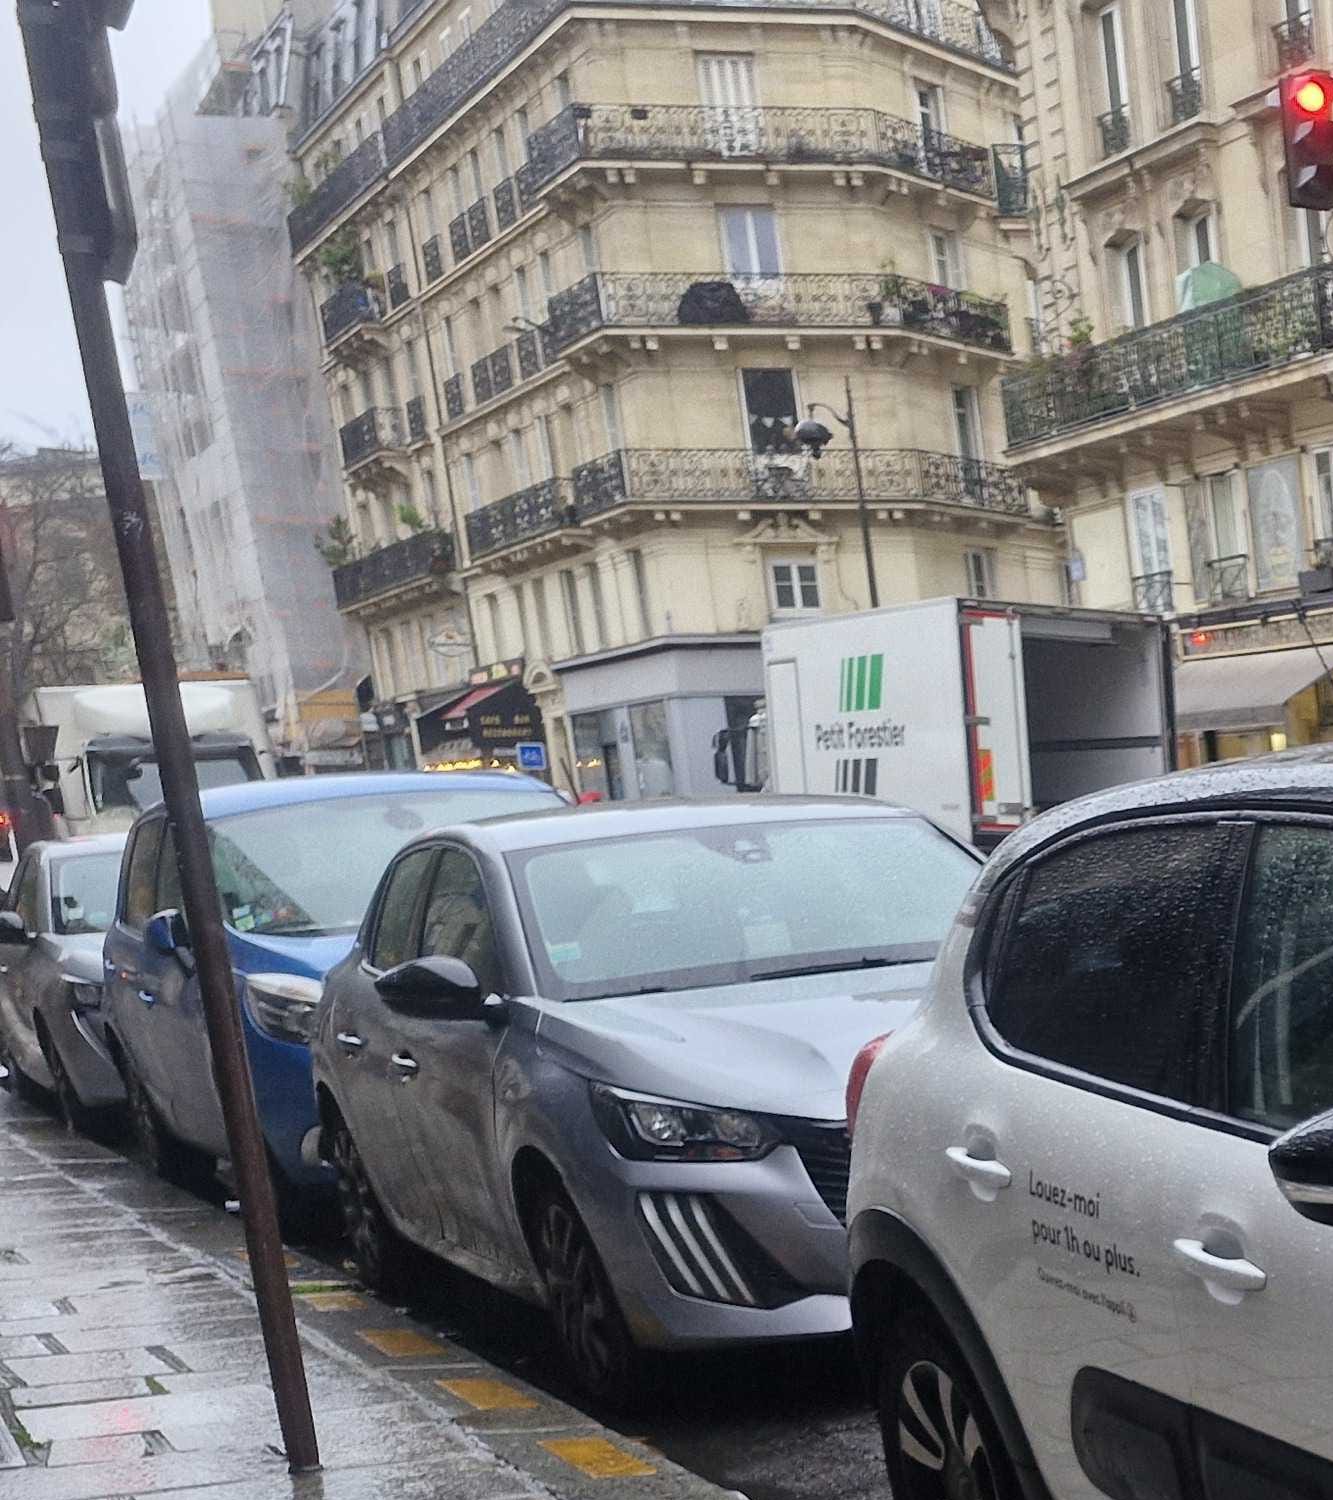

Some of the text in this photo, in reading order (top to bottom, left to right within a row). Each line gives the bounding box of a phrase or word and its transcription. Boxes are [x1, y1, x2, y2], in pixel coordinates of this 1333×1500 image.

[815, 719, 905, 750] Petit Forestier
[1029, 1169, 1100, 1219] Louez-moi
[1032, 1218, 1140, 1278] pour 1h ou plus.
